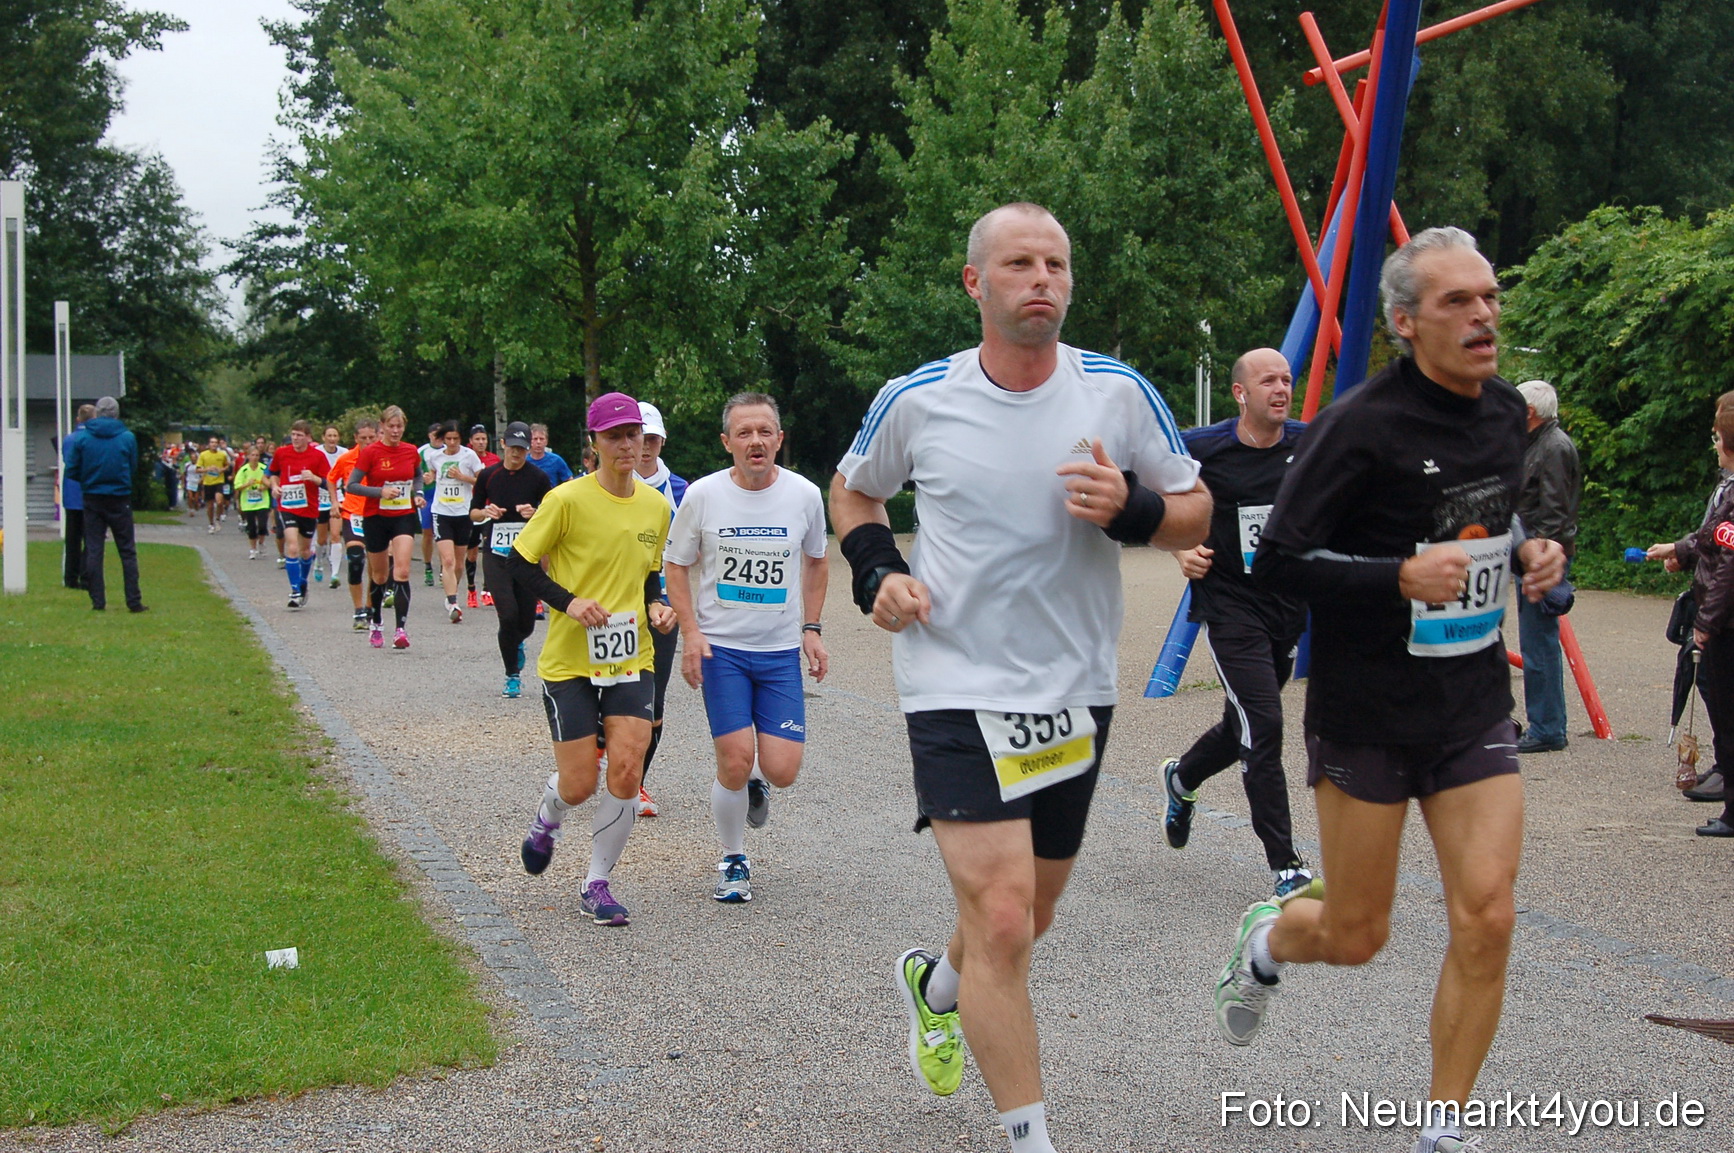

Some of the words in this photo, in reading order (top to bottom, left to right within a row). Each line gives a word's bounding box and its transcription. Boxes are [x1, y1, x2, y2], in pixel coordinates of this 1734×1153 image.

[283, 489, 305, 501] 2315
[444, 486, 460, 497] 410
[1241, 513, 1266, 521] PARTL
[718, 545, 744, 555] PARTL
[744, 549, 781, 557] Neumarkt
[722, 556, 785, 585] 2435
[1426, 563, 1504, 611] 497
[738, 589, 765, 603] Harry
[593, 629, 636, 660] 520
